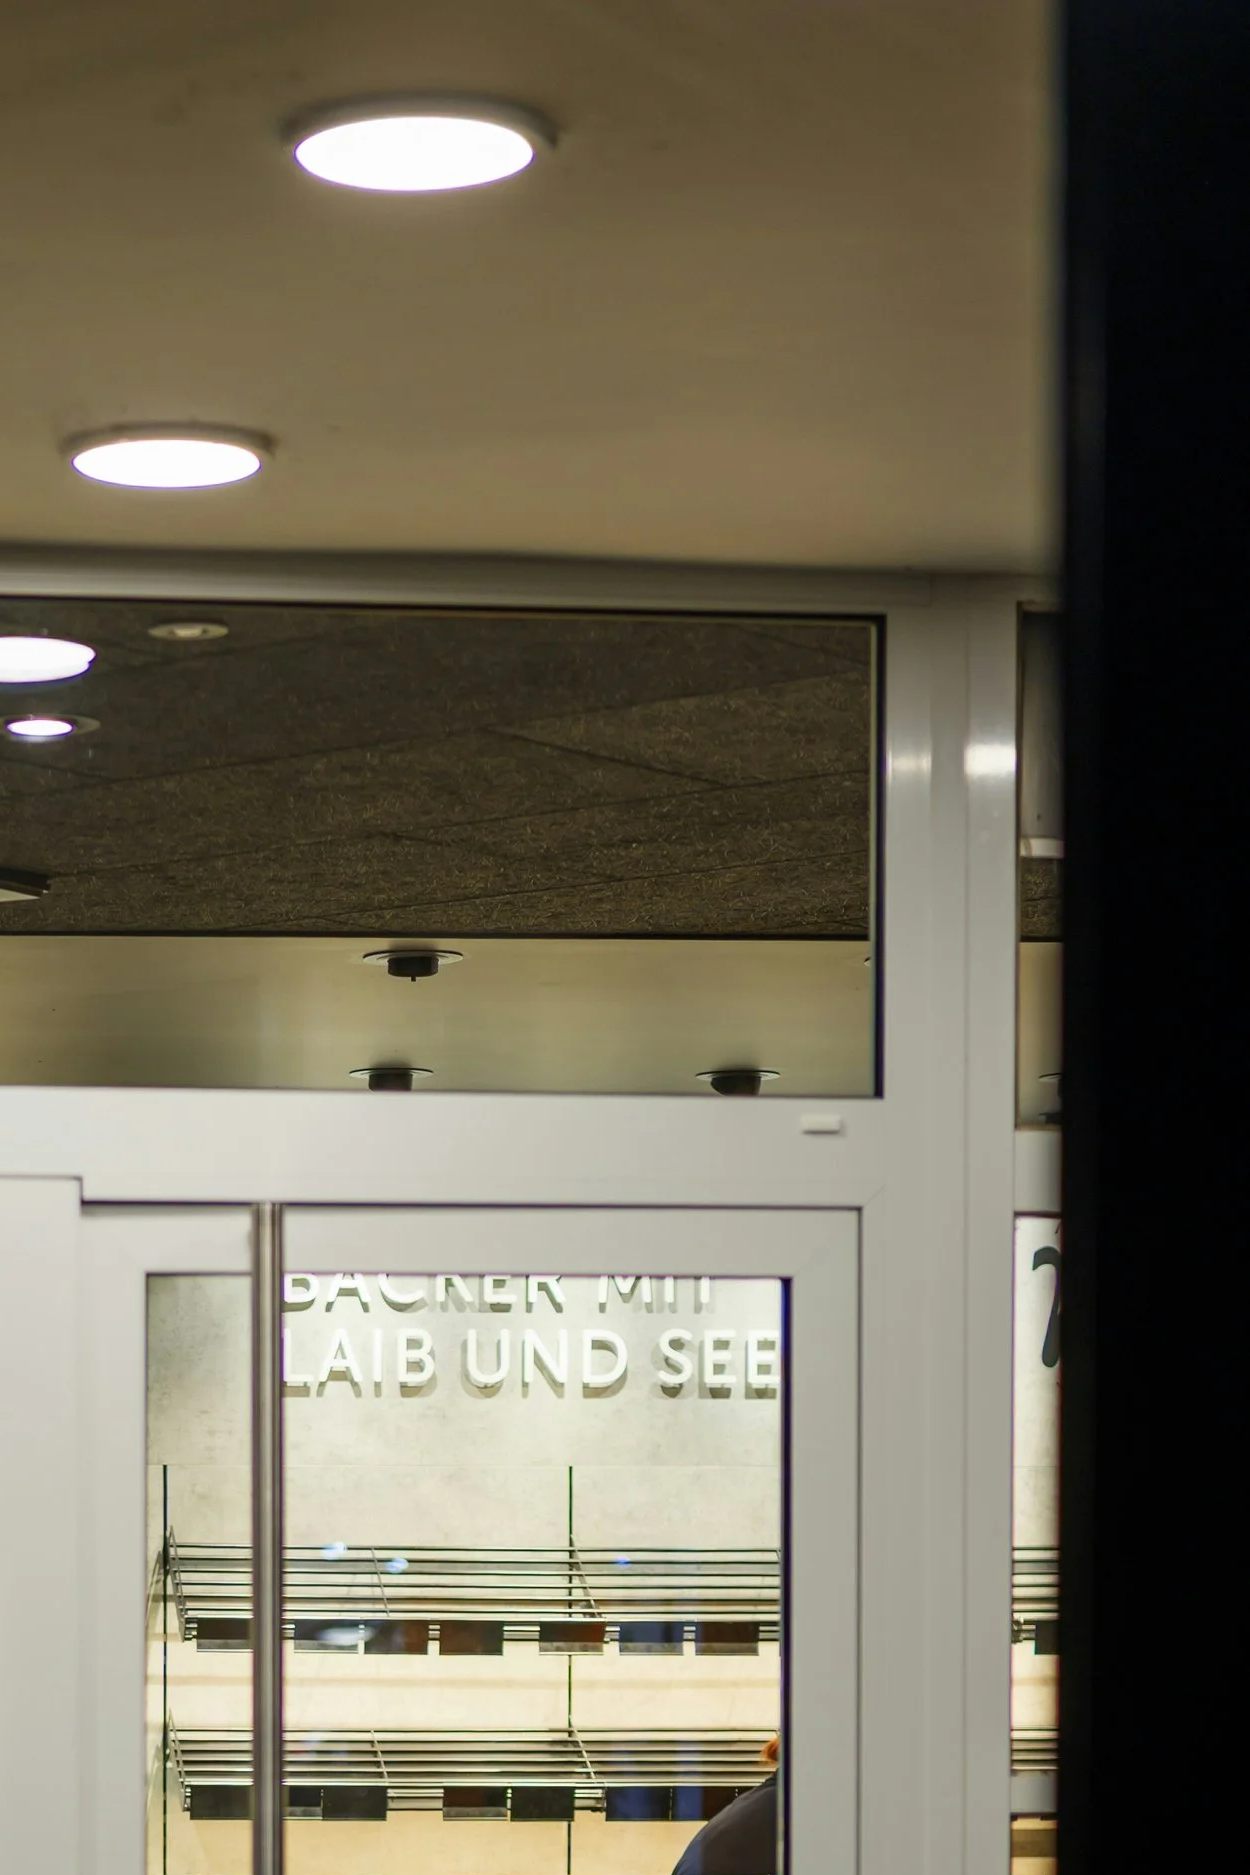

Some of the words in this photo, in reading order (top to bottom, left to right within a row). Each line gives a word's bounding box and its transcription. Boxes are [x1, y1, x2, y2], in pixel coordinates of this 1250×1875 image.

[283, 1328, 436, 1385] LAIB
[466, 1328, 628, 1387] UND
[658, 1328, 780, 1385] SEE
